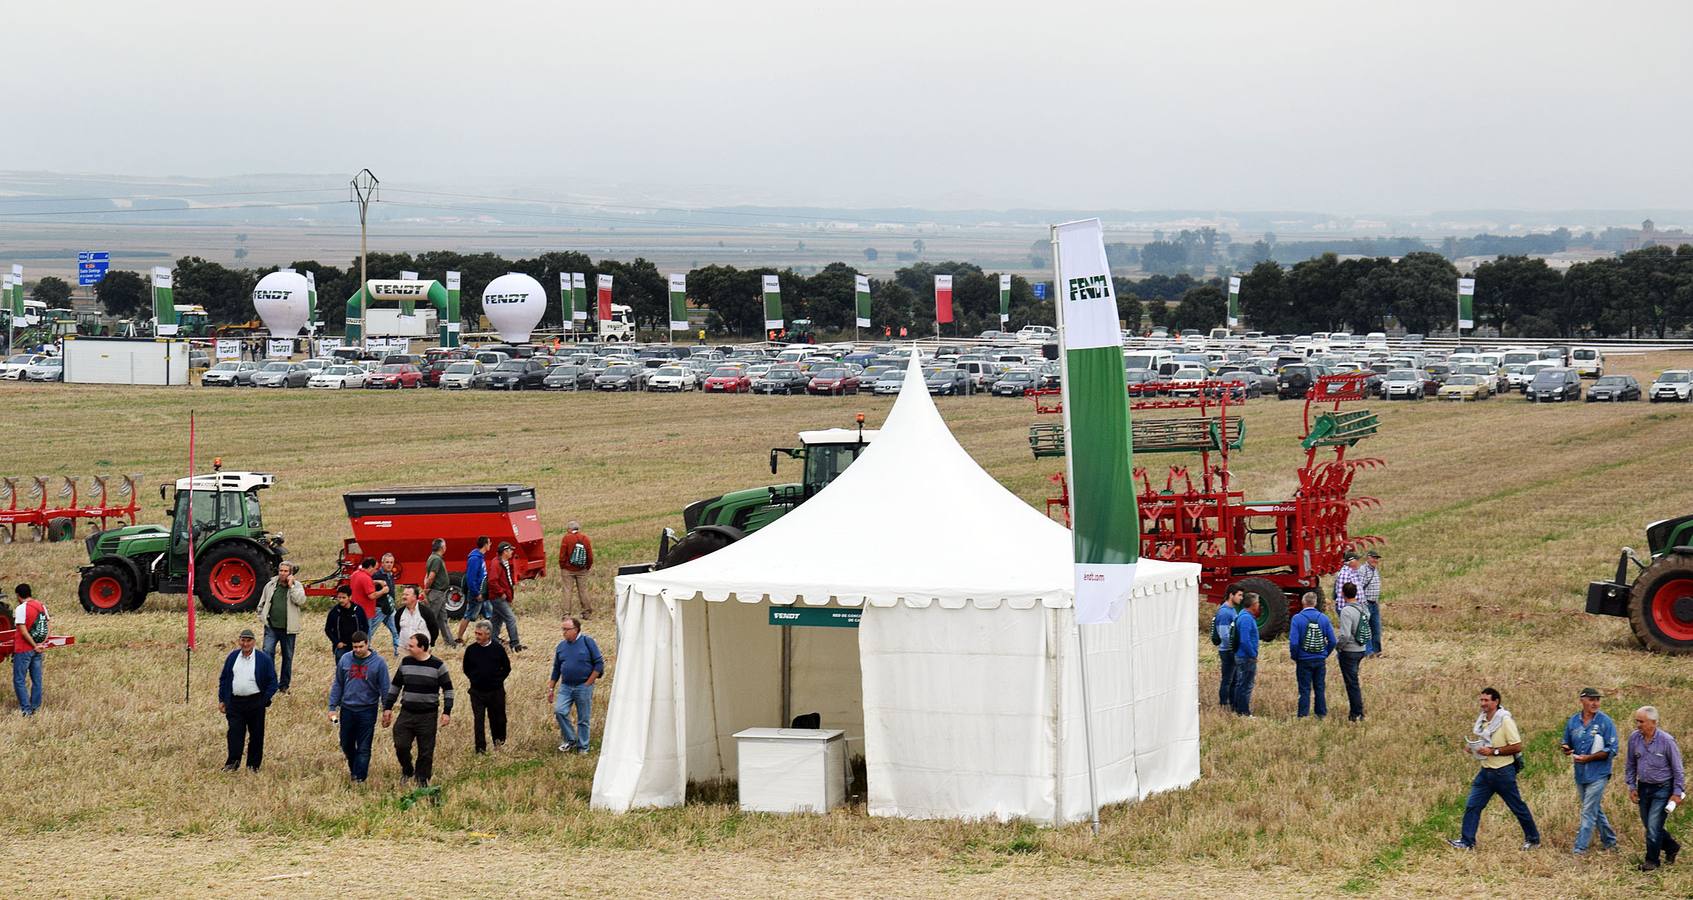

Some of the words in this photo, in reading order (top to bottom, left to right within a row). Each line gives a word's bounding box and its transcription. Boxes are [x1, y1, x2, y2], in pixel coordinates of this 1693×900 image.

[374, 284, 424, 296] FENDT
[485, 293, 529, 305] FENDT
[773, 611, 800, 620] FENDT
